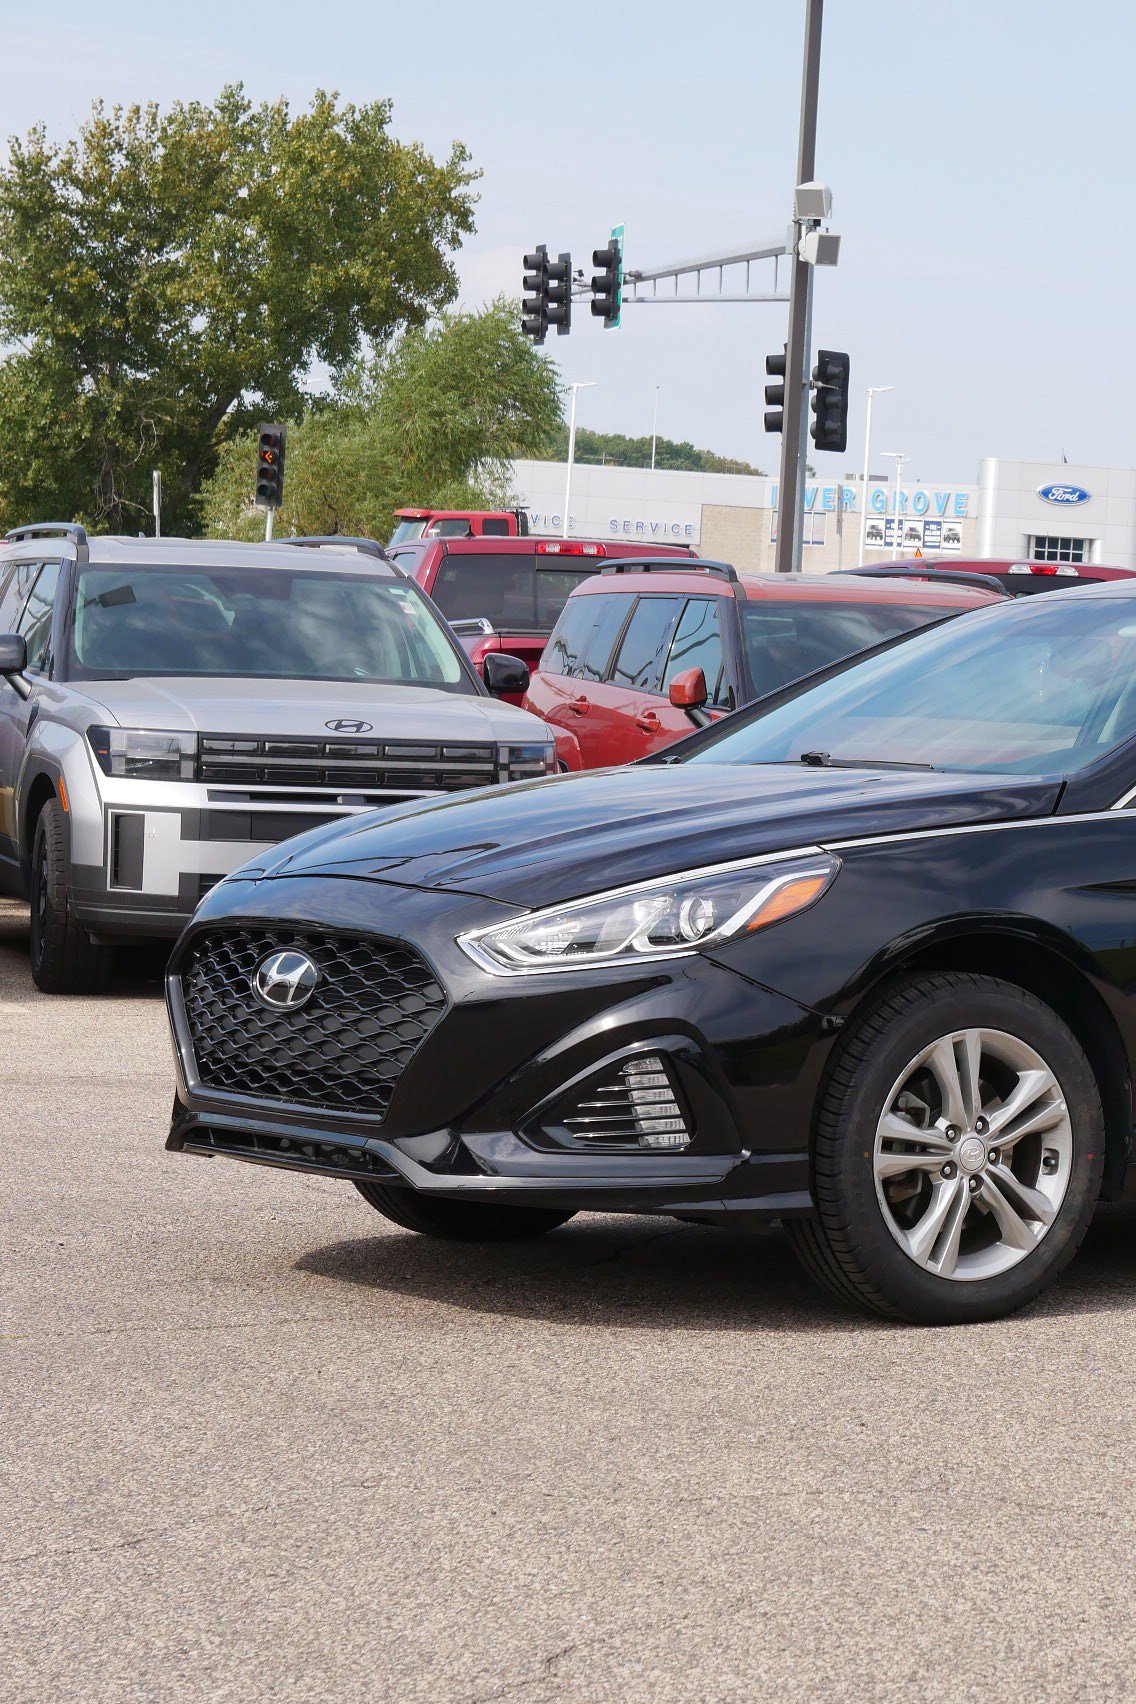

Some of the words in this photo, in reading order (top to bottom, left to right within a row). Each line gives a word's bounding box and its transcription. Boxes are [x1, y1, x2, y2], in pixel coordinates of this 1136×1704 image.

[770, 484, 855, 510] IVER
[871, 488, 968, 517] GROVE
[1048, 487, 1080, 502] Ford
[530, 513, 575, 528] VICE
[609, 519, 693, 535] SERVICE
